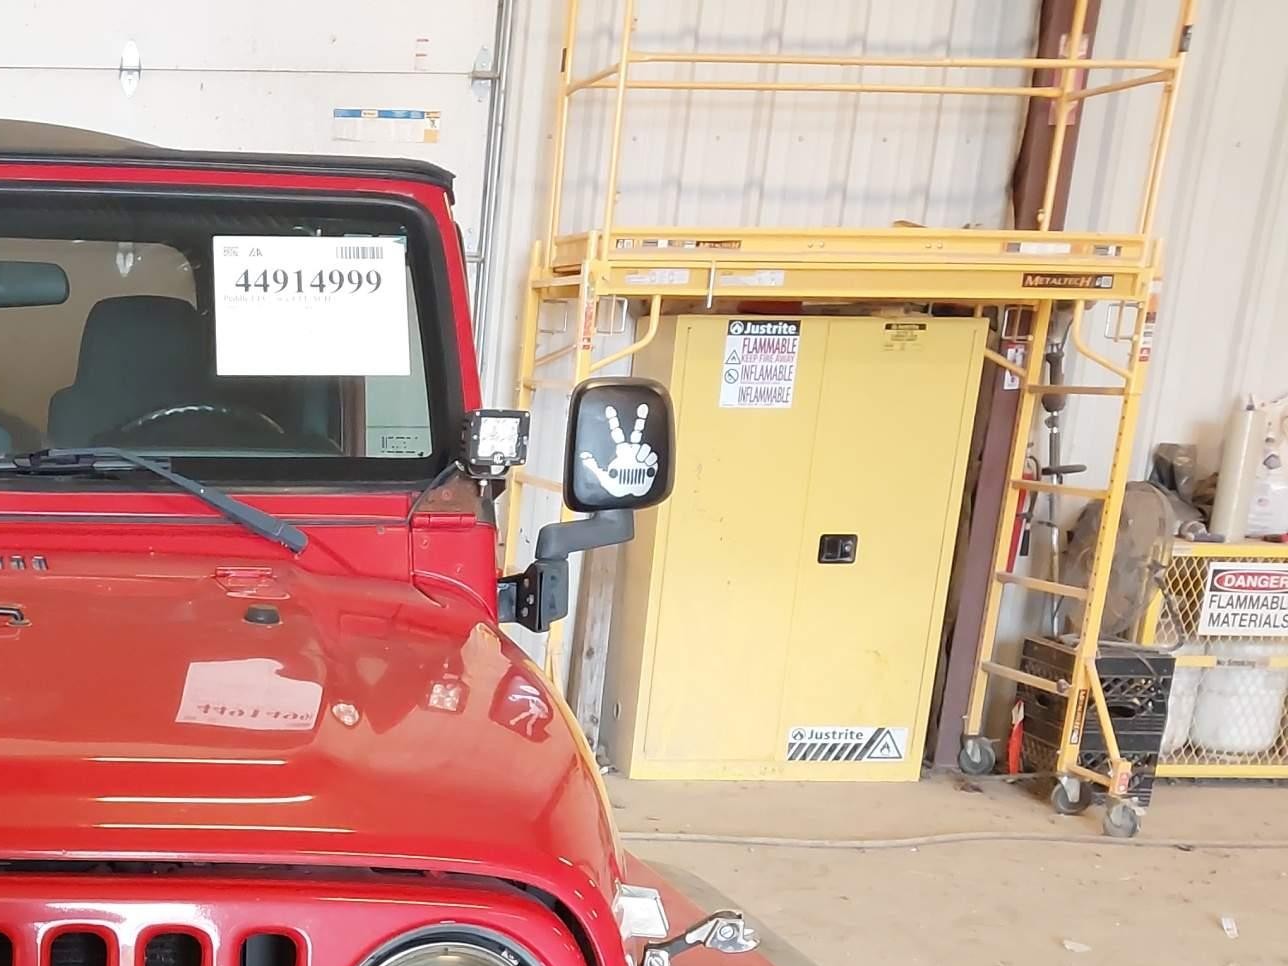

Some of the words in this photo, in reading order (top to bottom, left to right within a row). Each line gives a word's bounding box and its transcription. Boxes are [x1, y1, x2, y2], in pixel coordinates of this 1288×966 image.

[234, 268, 382, 294] 44914999
[744, 321, 797, 335] Justrite
[742, 337, 798, 354] FLAMMABLE
[740, 364, 794, 381] INFLAMABLE
[738, 386, 792, 403] INFLAMMABLE
[1223, 575, 1288, 589] DANGER
[1207, 612, 1288, 629] MATERIALS
[808, 729, 864, 740] Justrite
